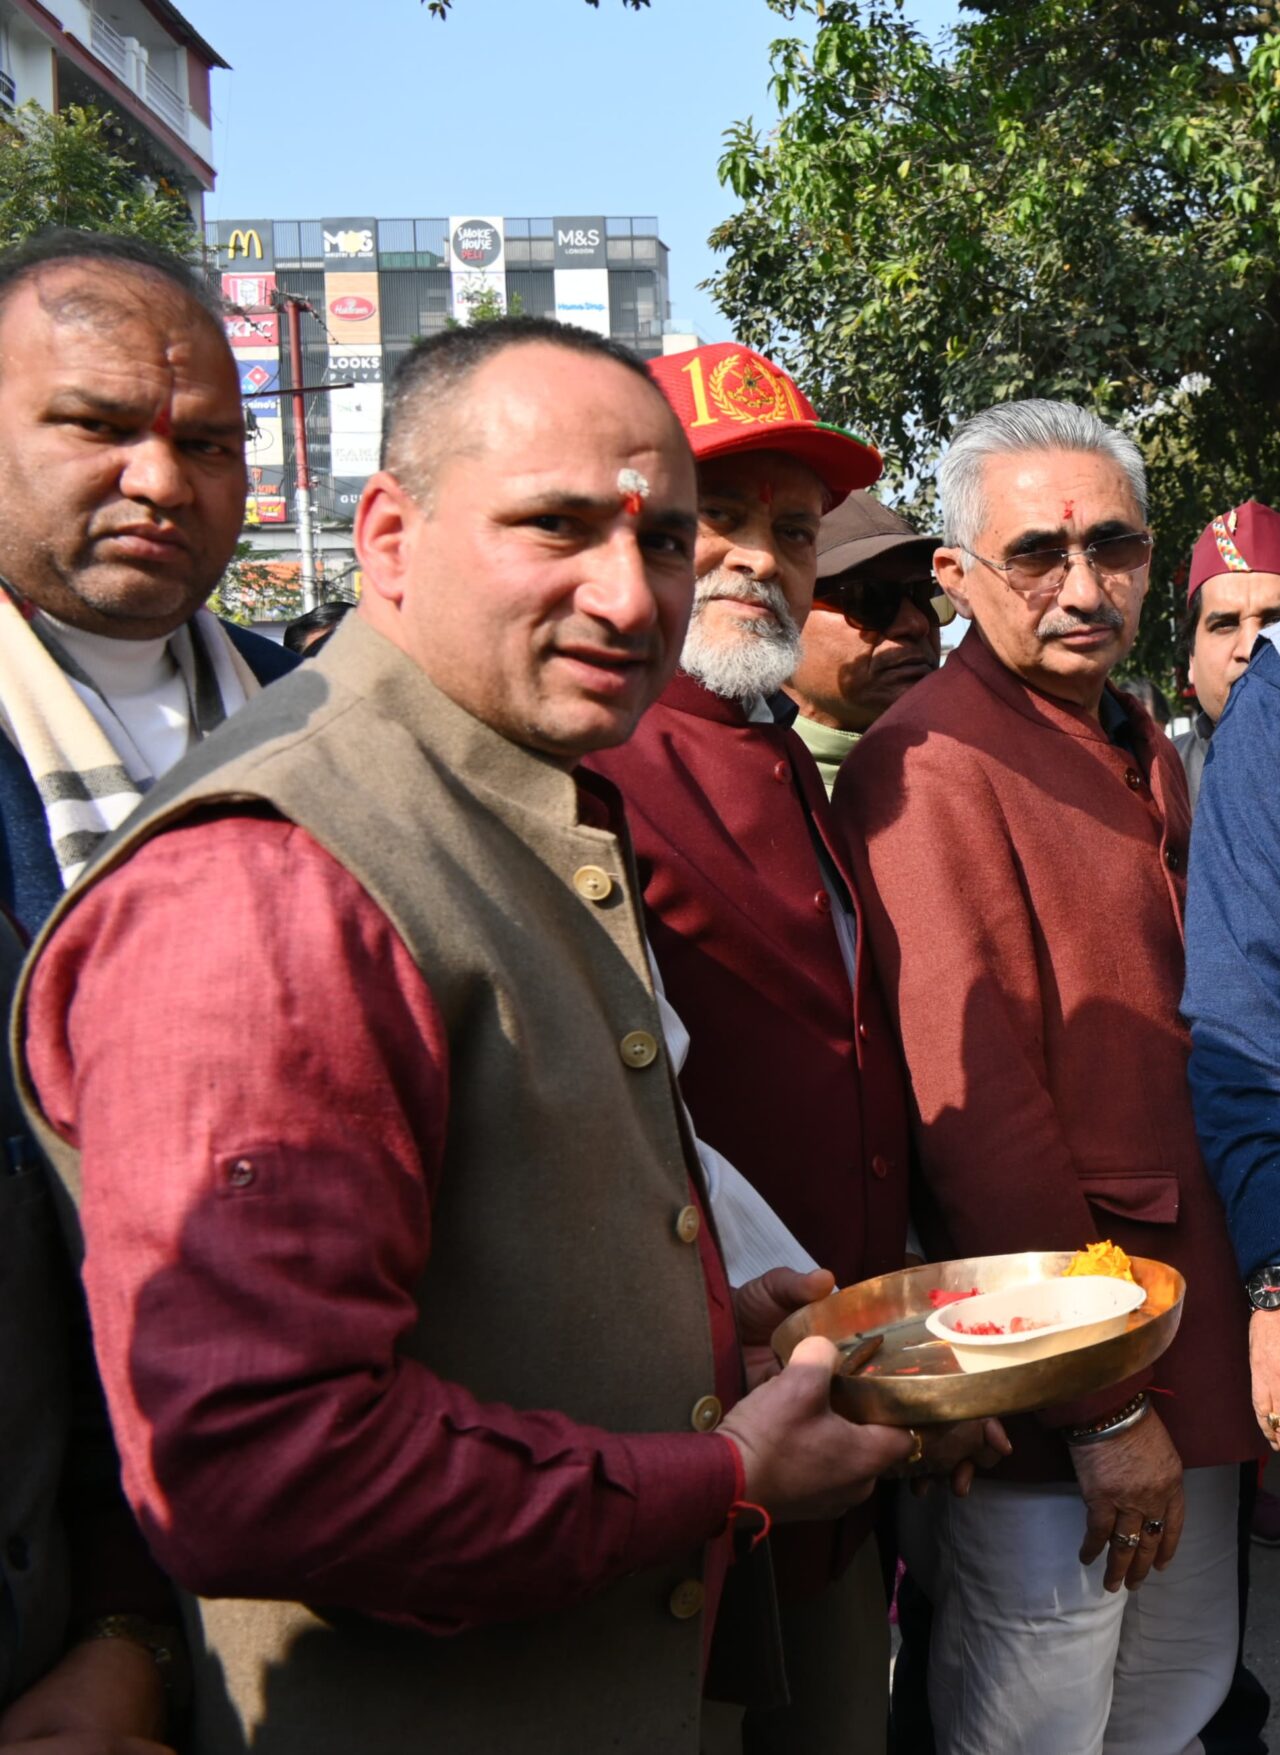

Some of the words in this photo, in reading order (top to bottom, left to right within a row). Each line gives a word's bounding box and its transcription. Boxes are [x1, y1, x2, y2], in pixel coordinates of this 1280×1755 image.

[558, 229, 600, 246] M&S
[226, 321, 273, 337] KFC
[329, 357, 380, 369] LOOKS
